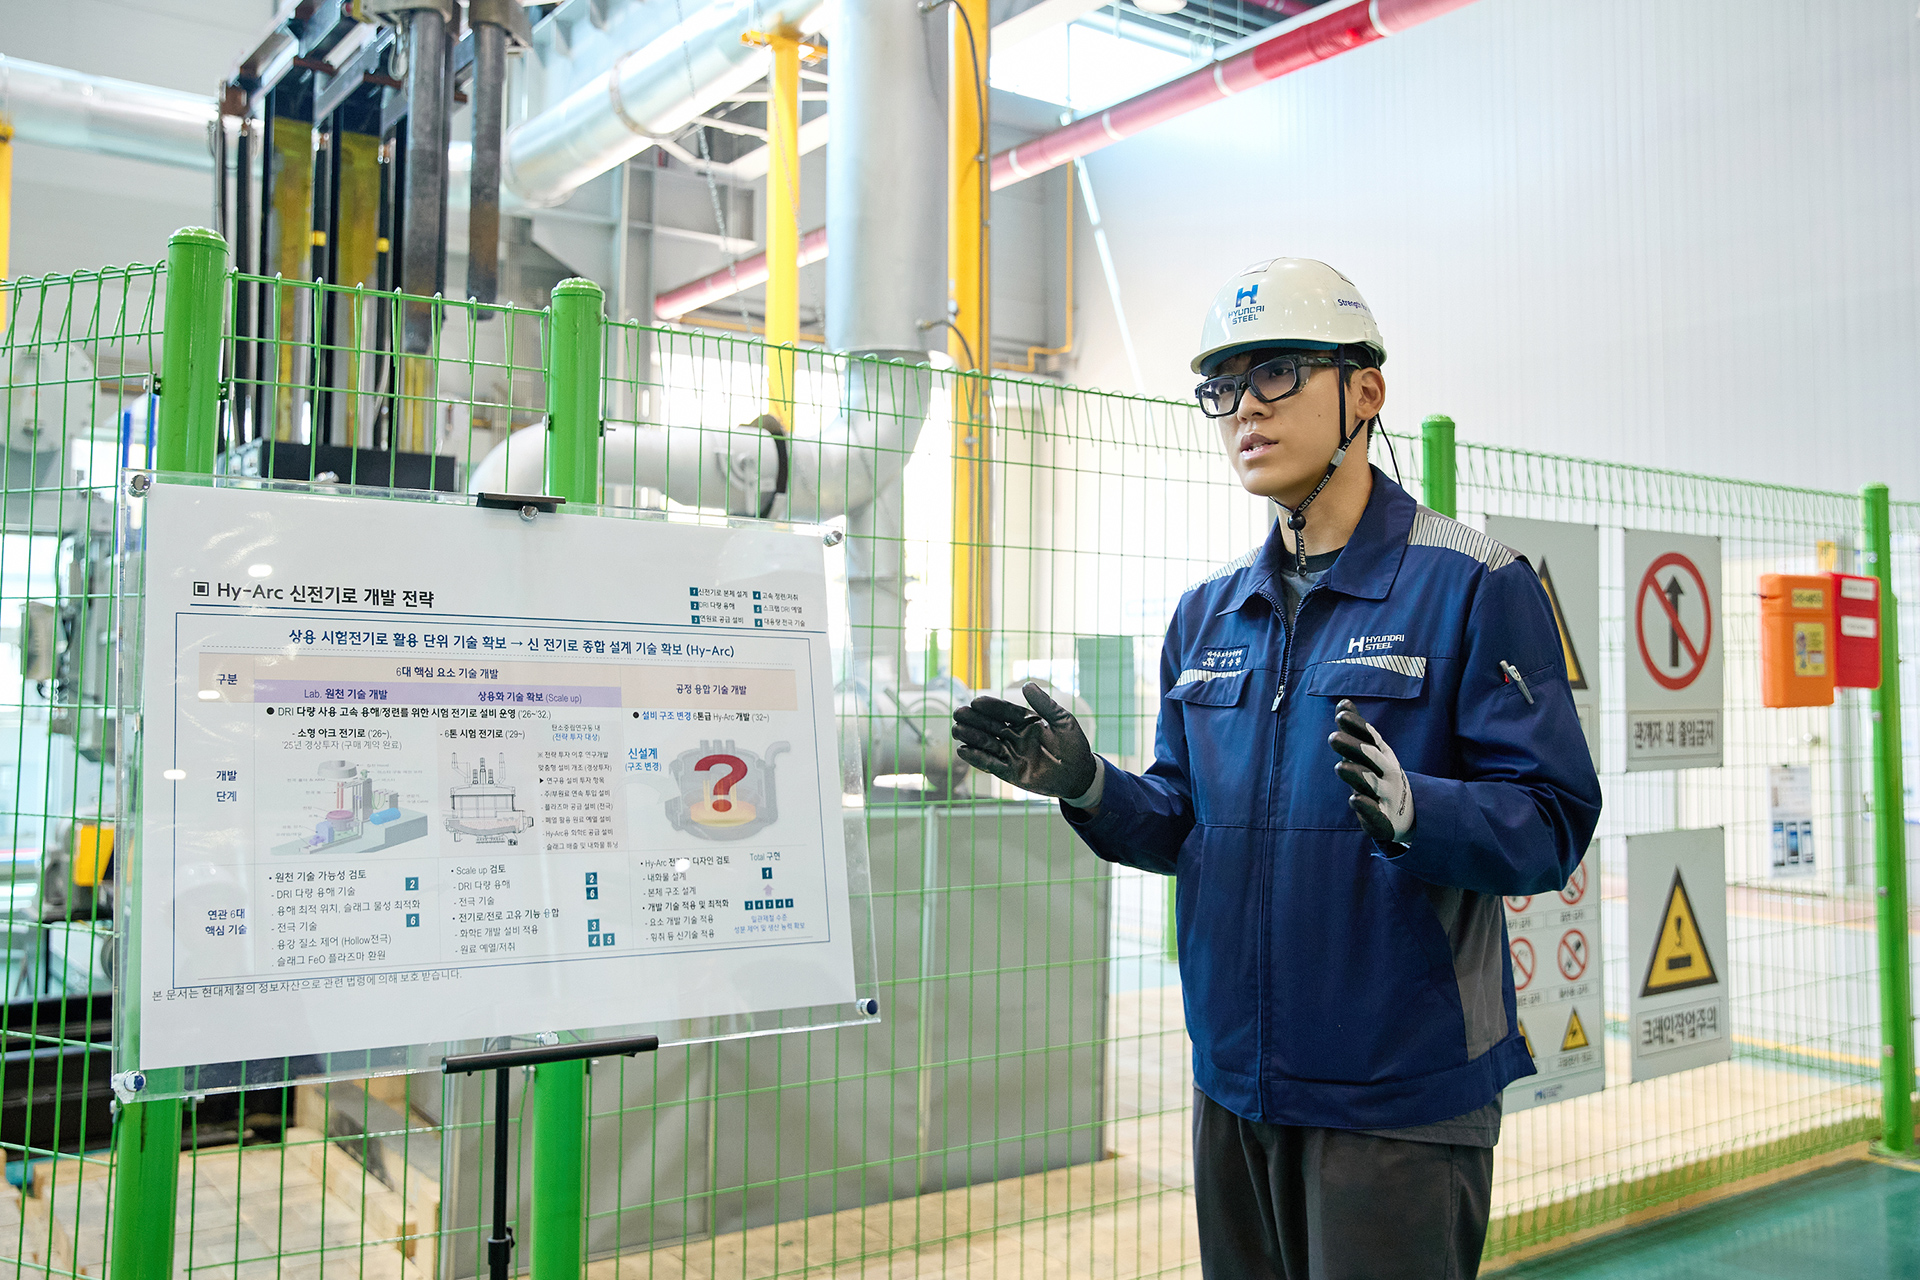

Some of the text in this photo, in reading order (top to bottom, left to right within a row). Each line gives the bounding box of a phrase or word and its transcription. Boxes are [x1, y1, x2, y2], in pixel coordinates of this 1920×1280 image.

[1228, 306, 1264, 318] HYUNDAI
[1232, 314, 1258, 324] STEEL
[218, 583, 434, 608] Hy-Arc 신전기로 개발 전략
[289, 629, 734, 658] 상용 시험전기로 활용 단위 기술 확보 신 전기로 종합 설계 기술 확보 (Hy-Arc)
[1365, 635, 1404, 643] HYUNDAI
[1365, 642, 1392, 650] STEEL
[396, 667, 498, 679] 6대 핵심 요소 기술 개발
[216, 674, 237, 685] 구분
[304, 689, 388, 700] Lab. 원천 기술 개발
[676, 684, 746, 695] 공정 융합 기술 개발
[478, 691, 582, 704] 상용화 기술 확보 (Scale up)
[278, 708, 294, 716] DRI
[297, 707, 315, 717] 다량
[318, 707, 337, 717] 사용
[340, 707, 358, 717] 고속
[411, 708, 429, 717] 위한
[431, 708, 449, 718] 시험
[451, 708, 477, 718] 전기로
[480, 709, 497, 718] 설비
[499, 709, 516, 719] 운영
[642, 711, 657, 720] 설비
[660, 712, 674, 720] 구조
[677, 712, 691, 721] 변경
[693, 712, 711, 721] 6톤급
[713, 713, 734, 722] Hy-Arc
[736, 712, 750, 722] 개발
[298, 728, 315, 738] 소형
[318, 729, 336, 738] 아크
[339, 728, 365, 738] 전기로
[445, 730, 457, 738] 6톤
[460, 729, 476, 738] 시험
[479, 729, 503, 738] 전기로
[552, 733, 600, 742] (전략 투자 대상)
[628, 748, 658, 759] 신설계
[625, 762, 662, 772] (구조 변경)
[216, 770, 237, 781] 개발
[216, 791, 237, 802] 단계
[456, 865, 506, 875] Scale up 검토
[275, 869, 366, 883] 원천 기술 가능성 검토
[458, 879, 510, 890] DRI 다량 용해
[277, 887, 355, 899] DRI 다량 용해 기술
[459, 896, 494, 907] 전극 기술
[277, 899, 420, 916] 용해 최적 위치, 슬래그 물성 최적화
[207, 908, 246, 920] 연관 6대
[459, 908, 559, 923] 전기로/전로 고유 기능 융합
[205, 924, 247, 936] 핵심 기술
[277, 921, 317, 933] 전극 기술
[460, 925, 538, 938] 화학E 개발 설비 적용
[277, 950, 386, 967] 슬래그 FeO 플라즈마 환원
[152, 969, 462, 1001] 본 문서는 현대제철의 정보자산으로 관련 법령에 의해 보호 받습니다.
